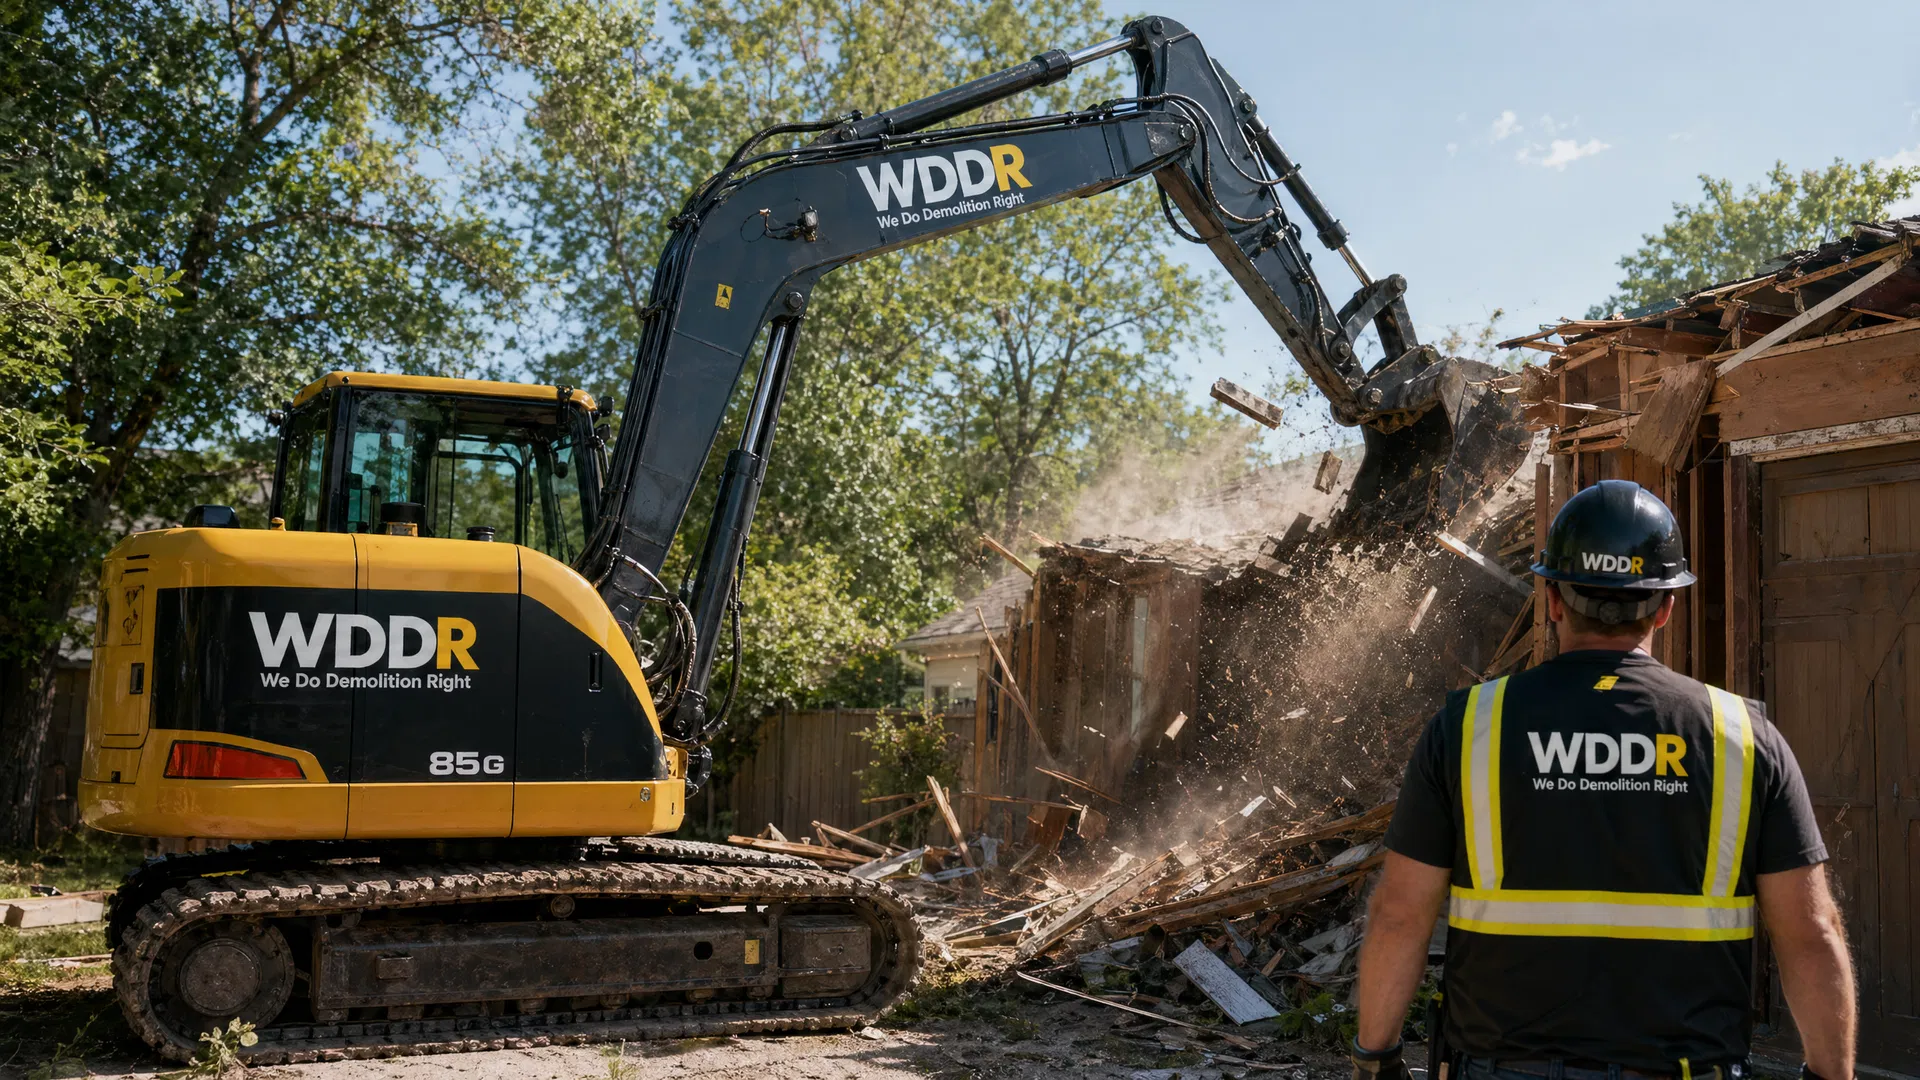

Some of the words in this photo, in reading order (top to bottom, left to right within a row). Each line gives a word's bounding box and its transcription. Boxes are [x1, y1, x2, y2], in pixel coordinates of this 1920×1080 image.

[856, 143, 1033, 212] WDDR
[876, 215, 899, 229] We
[901, 212, 920, 225] Do
[922, 199, 991, 221] Demolition
[993, 192, 1025, 209] Right
[1582, 552, 1644, 574] WDDR
[248, 611, 480, 670] WDDR
[260, 673, 290, 688] We
[295, 673, 321, 688] Do
[326, 673, 422, 689] Demolition
[427, 673, 471, 692] Right
[429, 751, 504, 775] 85G
[1527, 732, 1688, 777] WDDR
[1532, 778, 1554, 790] We
[1558, 778, 1576, 790] Do
[1580, 778, 1650, 791] Demolition
[1654, 779, 1688, 795] Right
